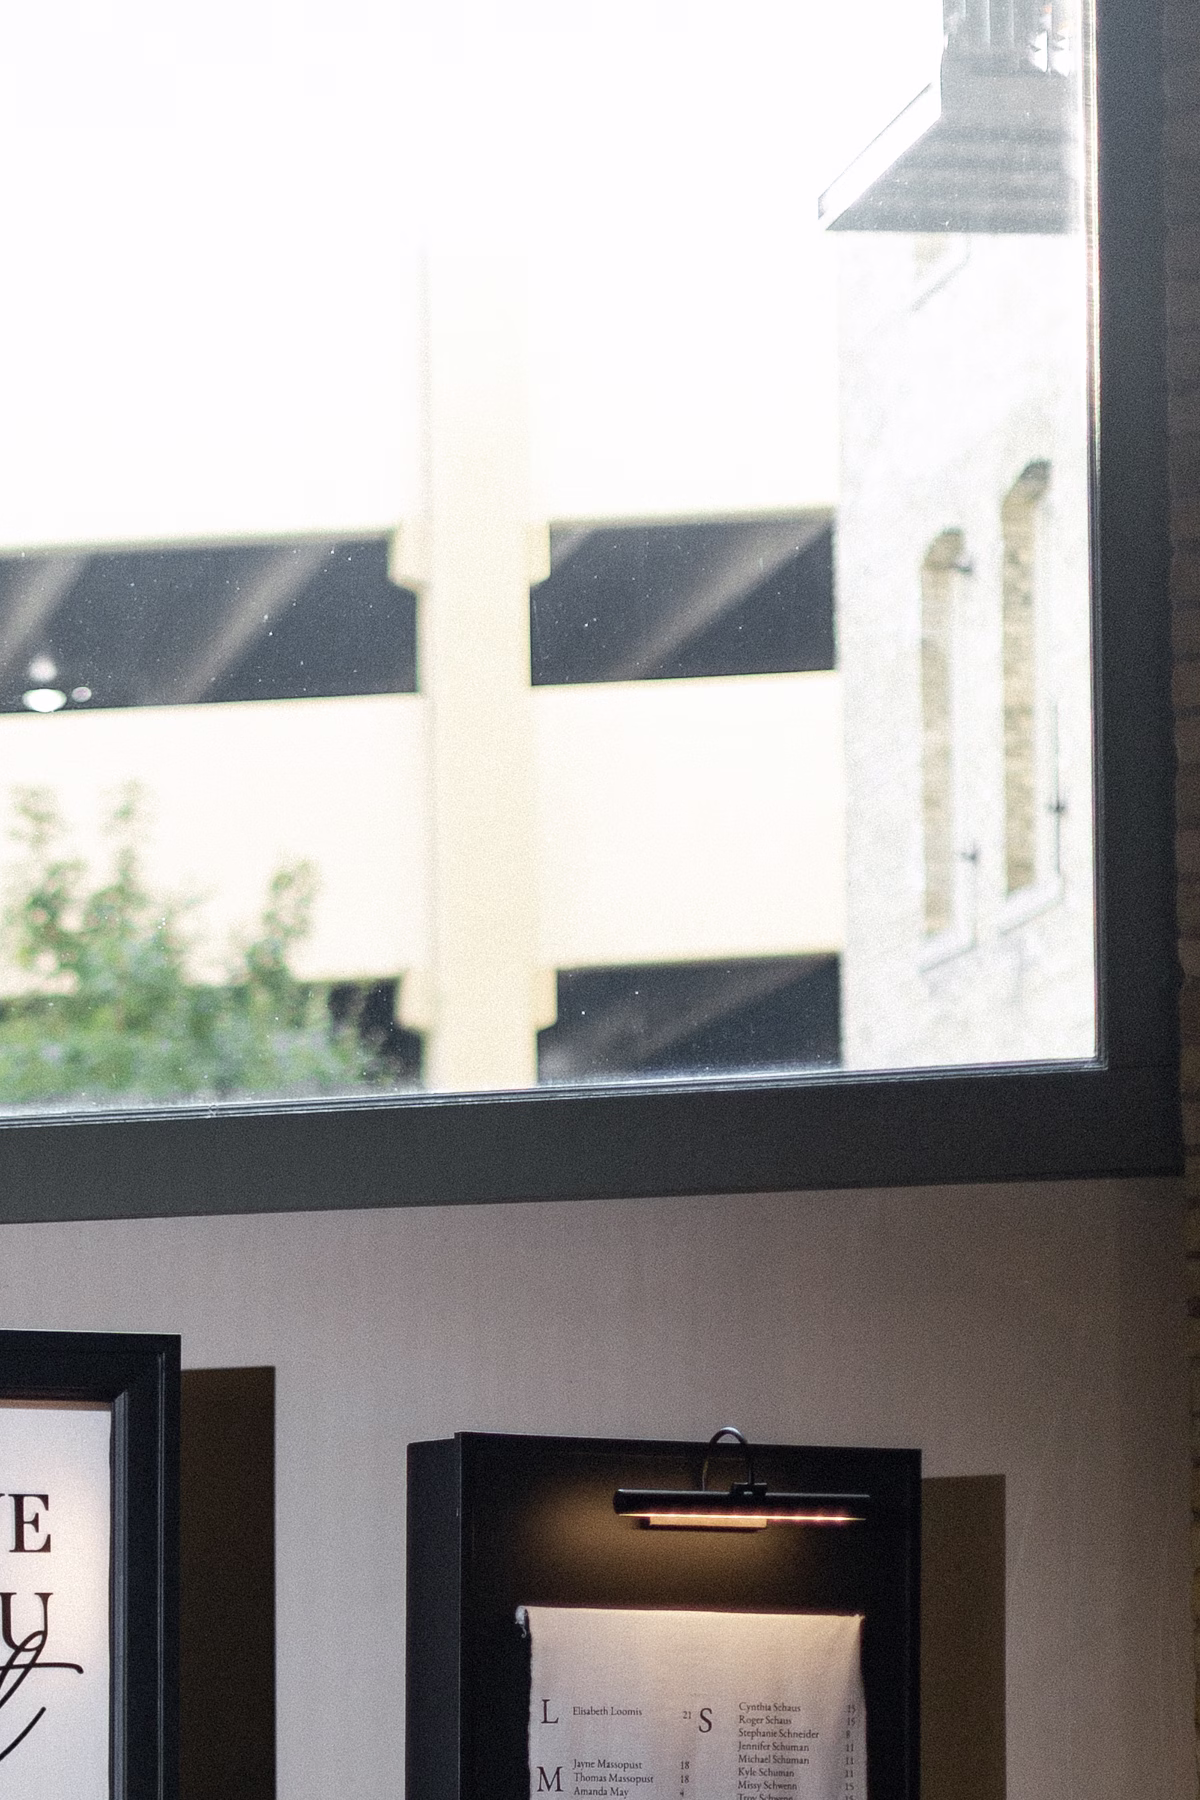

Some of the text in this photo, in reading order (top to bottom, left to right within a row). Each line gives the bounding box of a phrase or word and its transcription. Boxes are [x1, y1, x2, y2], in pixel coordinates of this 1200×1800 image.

[541, 1699, 559, 1723] L
[573, 1707, 691, 1719] Elisabeth Loomis 21
[699, 1708, 712, 1733] S
[739, 1716, 763, 1725] Roger
[766, 1716, 791, 1725] Schaus
[738, 1742, 770, 1753] Jennifer
[772, 1742, 809, 1751] Schuman
[537, 1767, 563, 1792] M
[574, 1774, 689, 1786] Thomas Massopust 18
